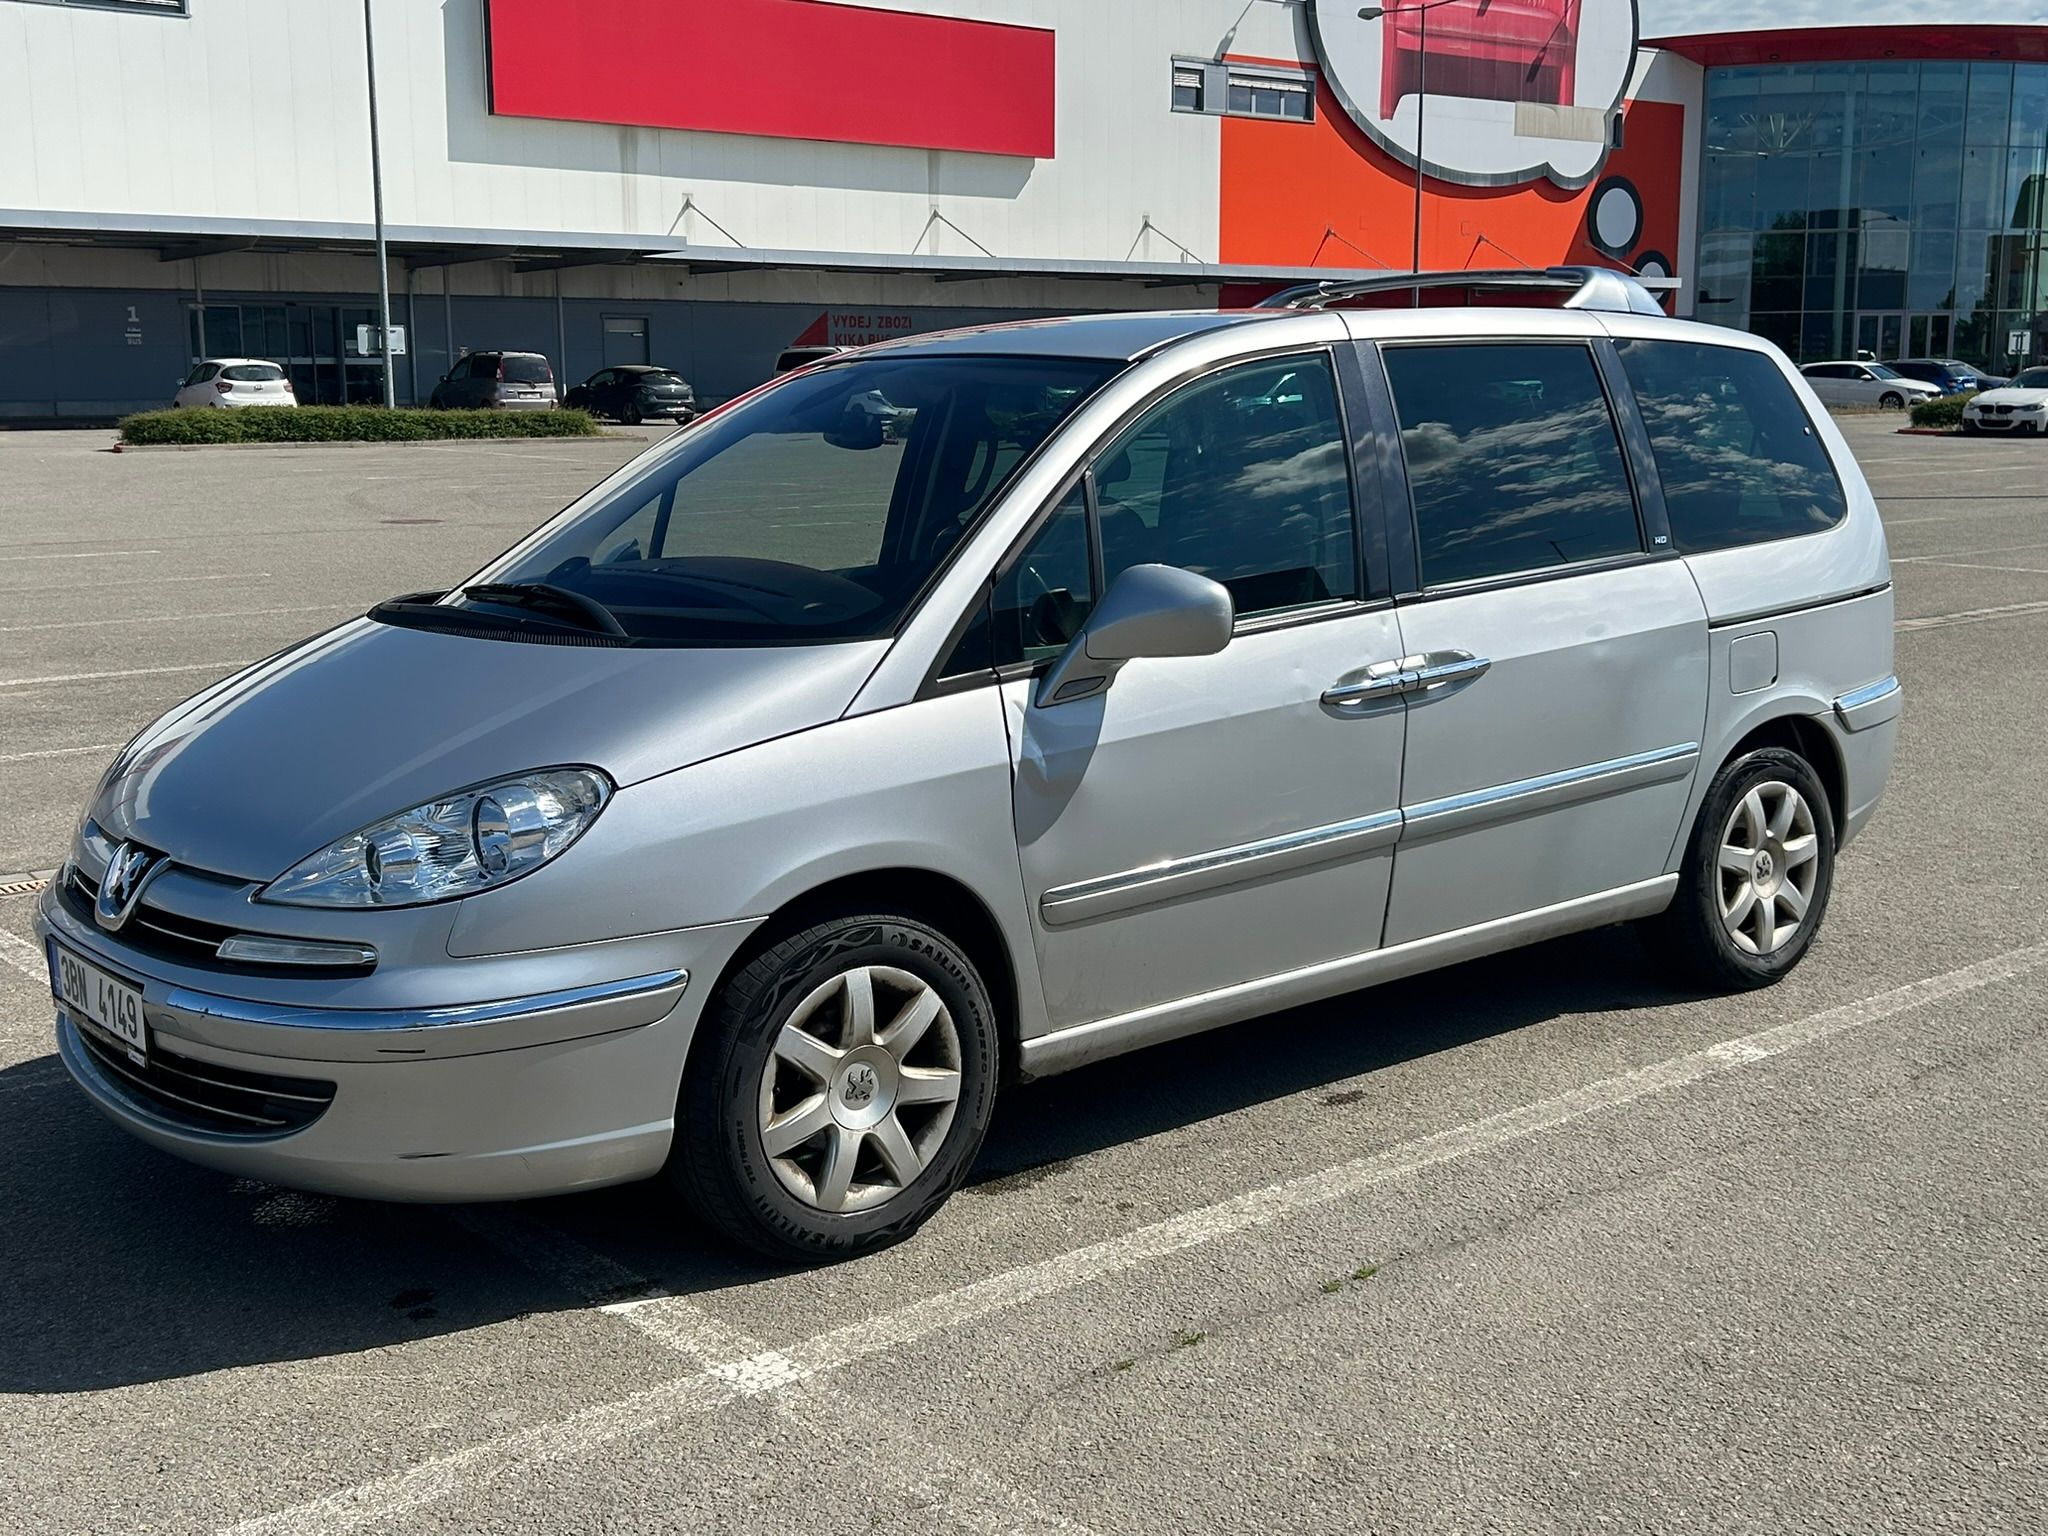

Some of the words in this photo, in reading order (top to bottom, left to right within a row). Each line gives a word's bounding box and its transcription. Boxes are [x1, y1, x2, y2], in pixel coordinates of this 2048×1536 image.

[127, 305, 140, 322] 1
[834, 333, 864, 346] KIKA
[61, 955, 89, 1010] 3BN
[98, 978, 138, 1039] 4149
